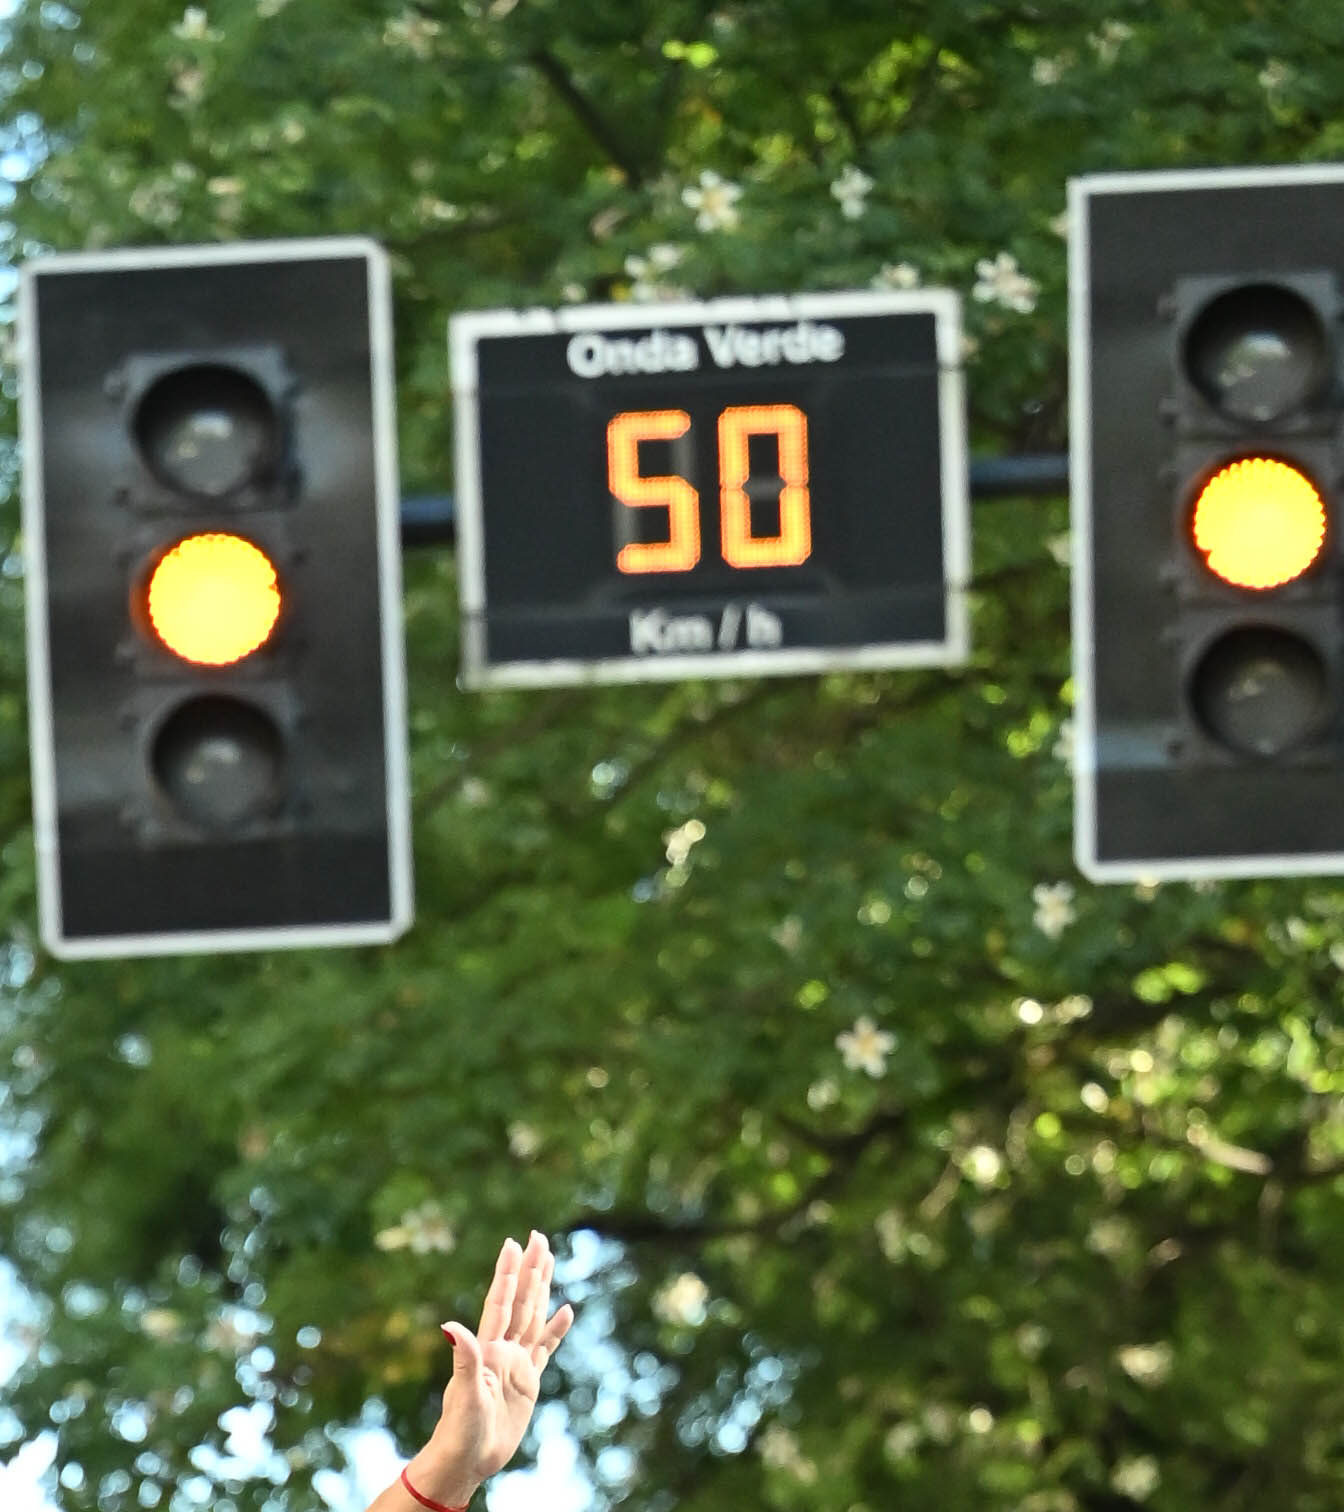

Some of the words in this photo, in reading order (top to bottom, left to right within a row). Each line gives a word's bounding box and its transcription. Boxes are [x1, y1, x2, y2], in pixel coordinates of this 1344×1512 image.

[567, 328, 700, 378] Onda
[704, 321, 846, 368] Verde
[606, 404, 812, 574] 50
[629, 607, 714, 655] Km
